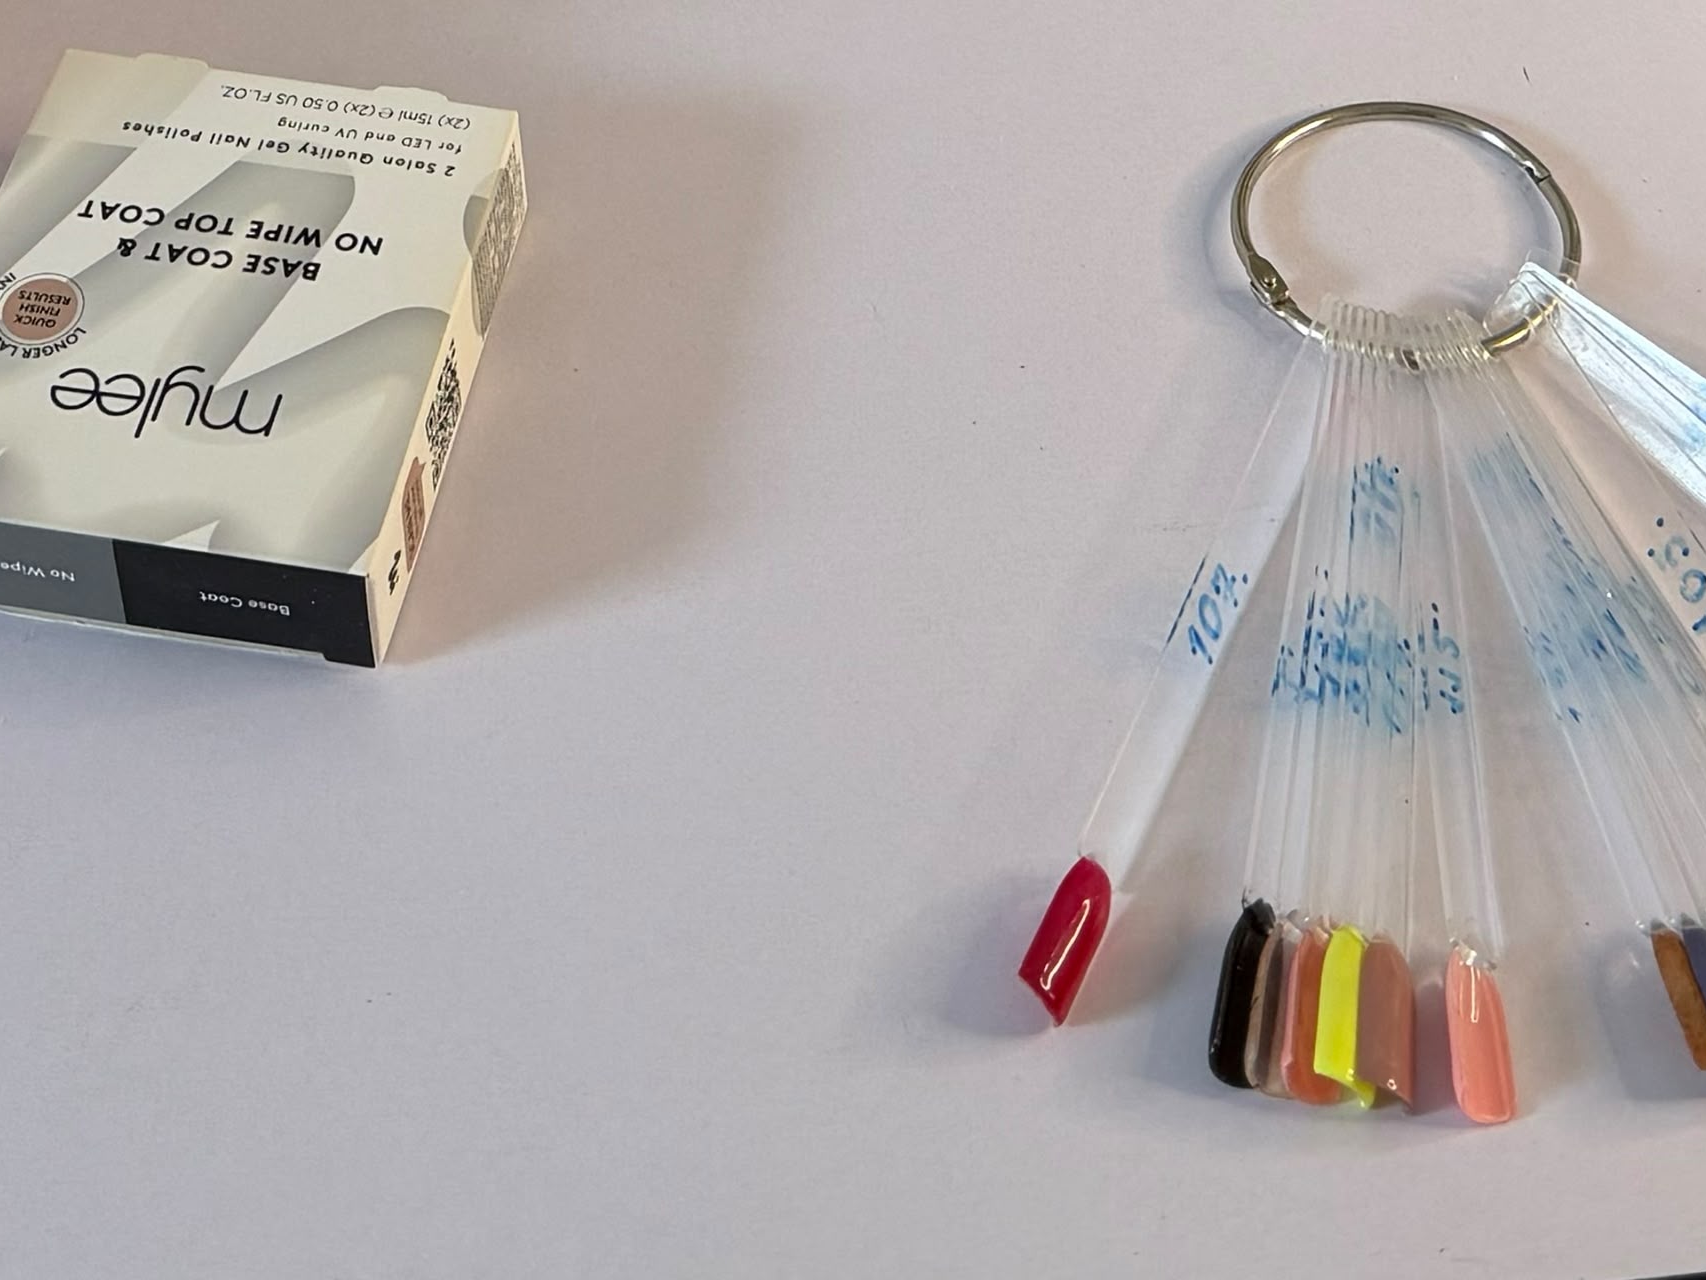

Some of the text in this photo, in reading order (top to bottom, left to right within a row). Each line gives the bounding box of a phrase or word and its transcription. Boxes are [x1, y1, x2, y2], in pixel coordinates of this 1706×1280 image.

[276, 92, 298, 107] US
[302, 96, 339, 112] 0.50
[343, 101, 376, 119] (2x)
[398, 110, 433, 126] 15ml
[437, 114, 472, 131] (2x)
[278, 116, 463, 156] for LED and UV curing
[122, 121, 456, 177] 2 Salon Quality Gel Nail Polishes
[77, 199, 384, 256] NO WIPE TOP COAT
[116, 237, 322, 282] BASE COAT &
[18, 290, 72, 306] RESULTS
[19, 303, 61, 317] FINISH
[13, 314, 57, 329] QUICK
[22, 327, 87, 359] LONGER
[50, 365, 283, 439] mylee
[0, 561, 45, 579] Wipe
[50, 568, 76, 583] No
[199, 590, 291, 616] Base Coat
